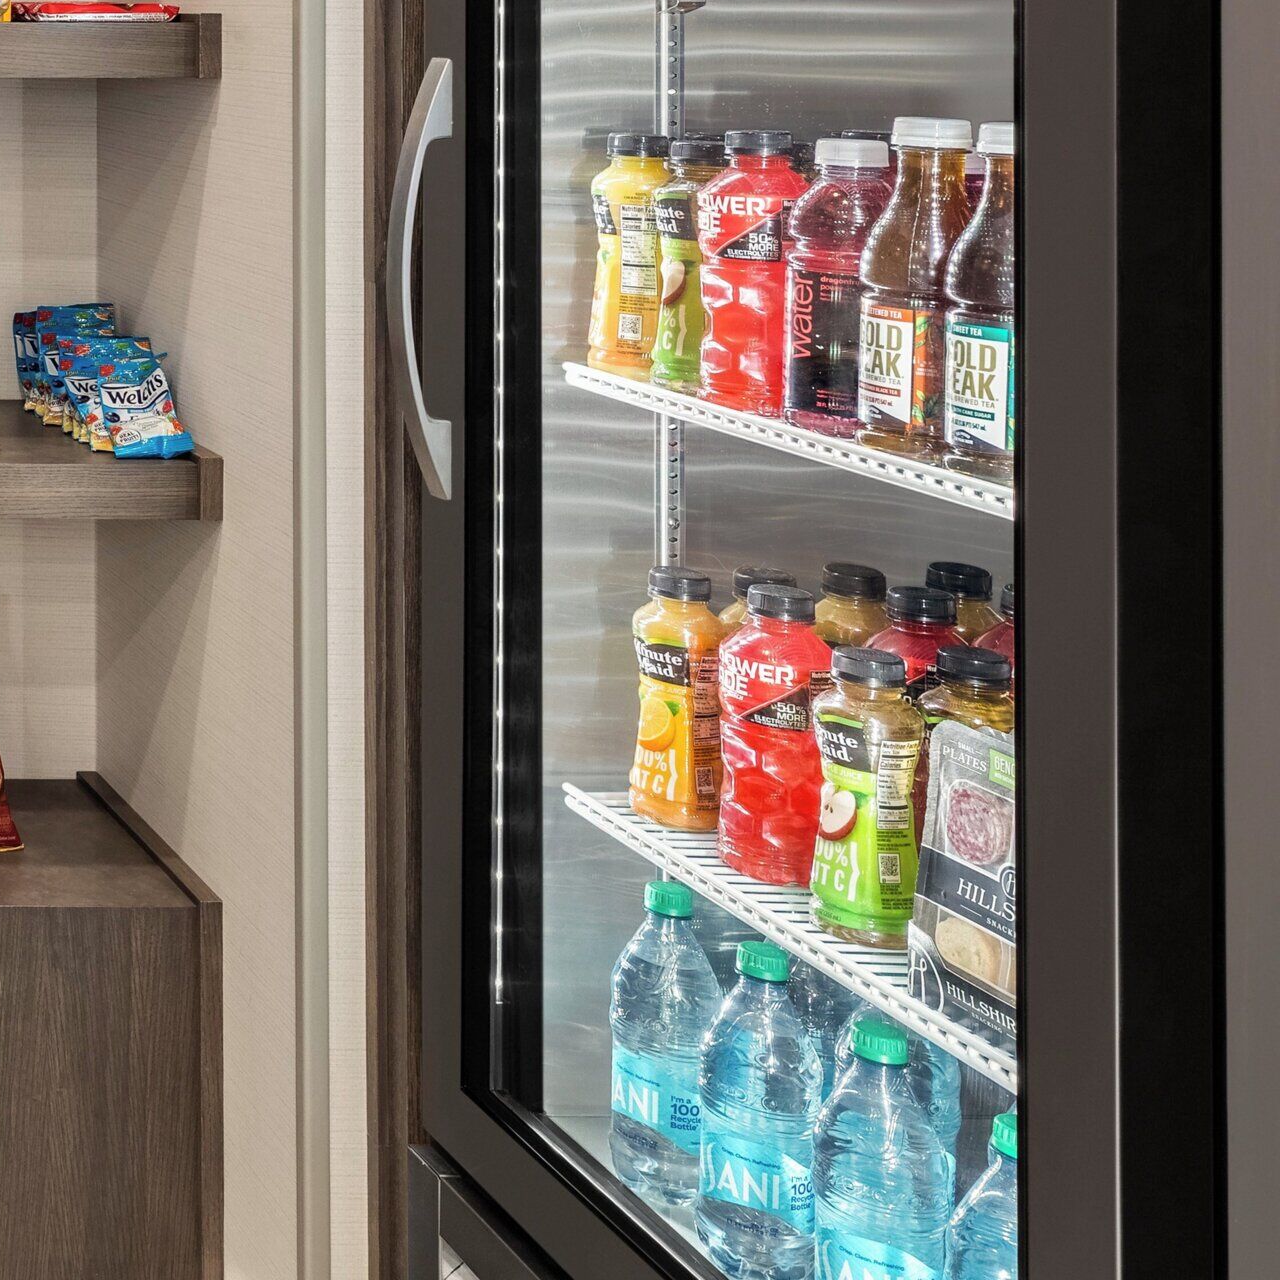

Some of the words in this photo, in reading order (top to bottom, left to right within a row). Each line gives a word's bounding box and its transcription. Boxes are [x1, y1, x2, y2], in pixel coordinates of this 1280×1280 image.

[749, 233, 779, 244] 50%
[727, 249, 778, 257] ELECTROLYTES
[749, 243, 779, 251] MORE
[792, 272, 814, 359] water
[890, 311, 902, 320] TEA
[970, 328, 982, 336] TEA
[948, 339, 997, 372] OLD
[860, 347, 902, 379] EAK
[889, 378, 901, 386] TEA
[953, 368, 995, 401] EAK
[105, 372, 164, 405] Welch's
[955, 397, 979, 406] BREWED
[981, 401, 995, 409] TEA
[754, 714, 806, 728] ELECTROLYTES
[777, 713, 806, 722] MORE
[958, 742, 974, 754] SMALL
[942, 746, 987, 772] PLATES
[670, 1122, 698, 1131] Bottle
[874, 1258, 905, 1272] Refreshing
